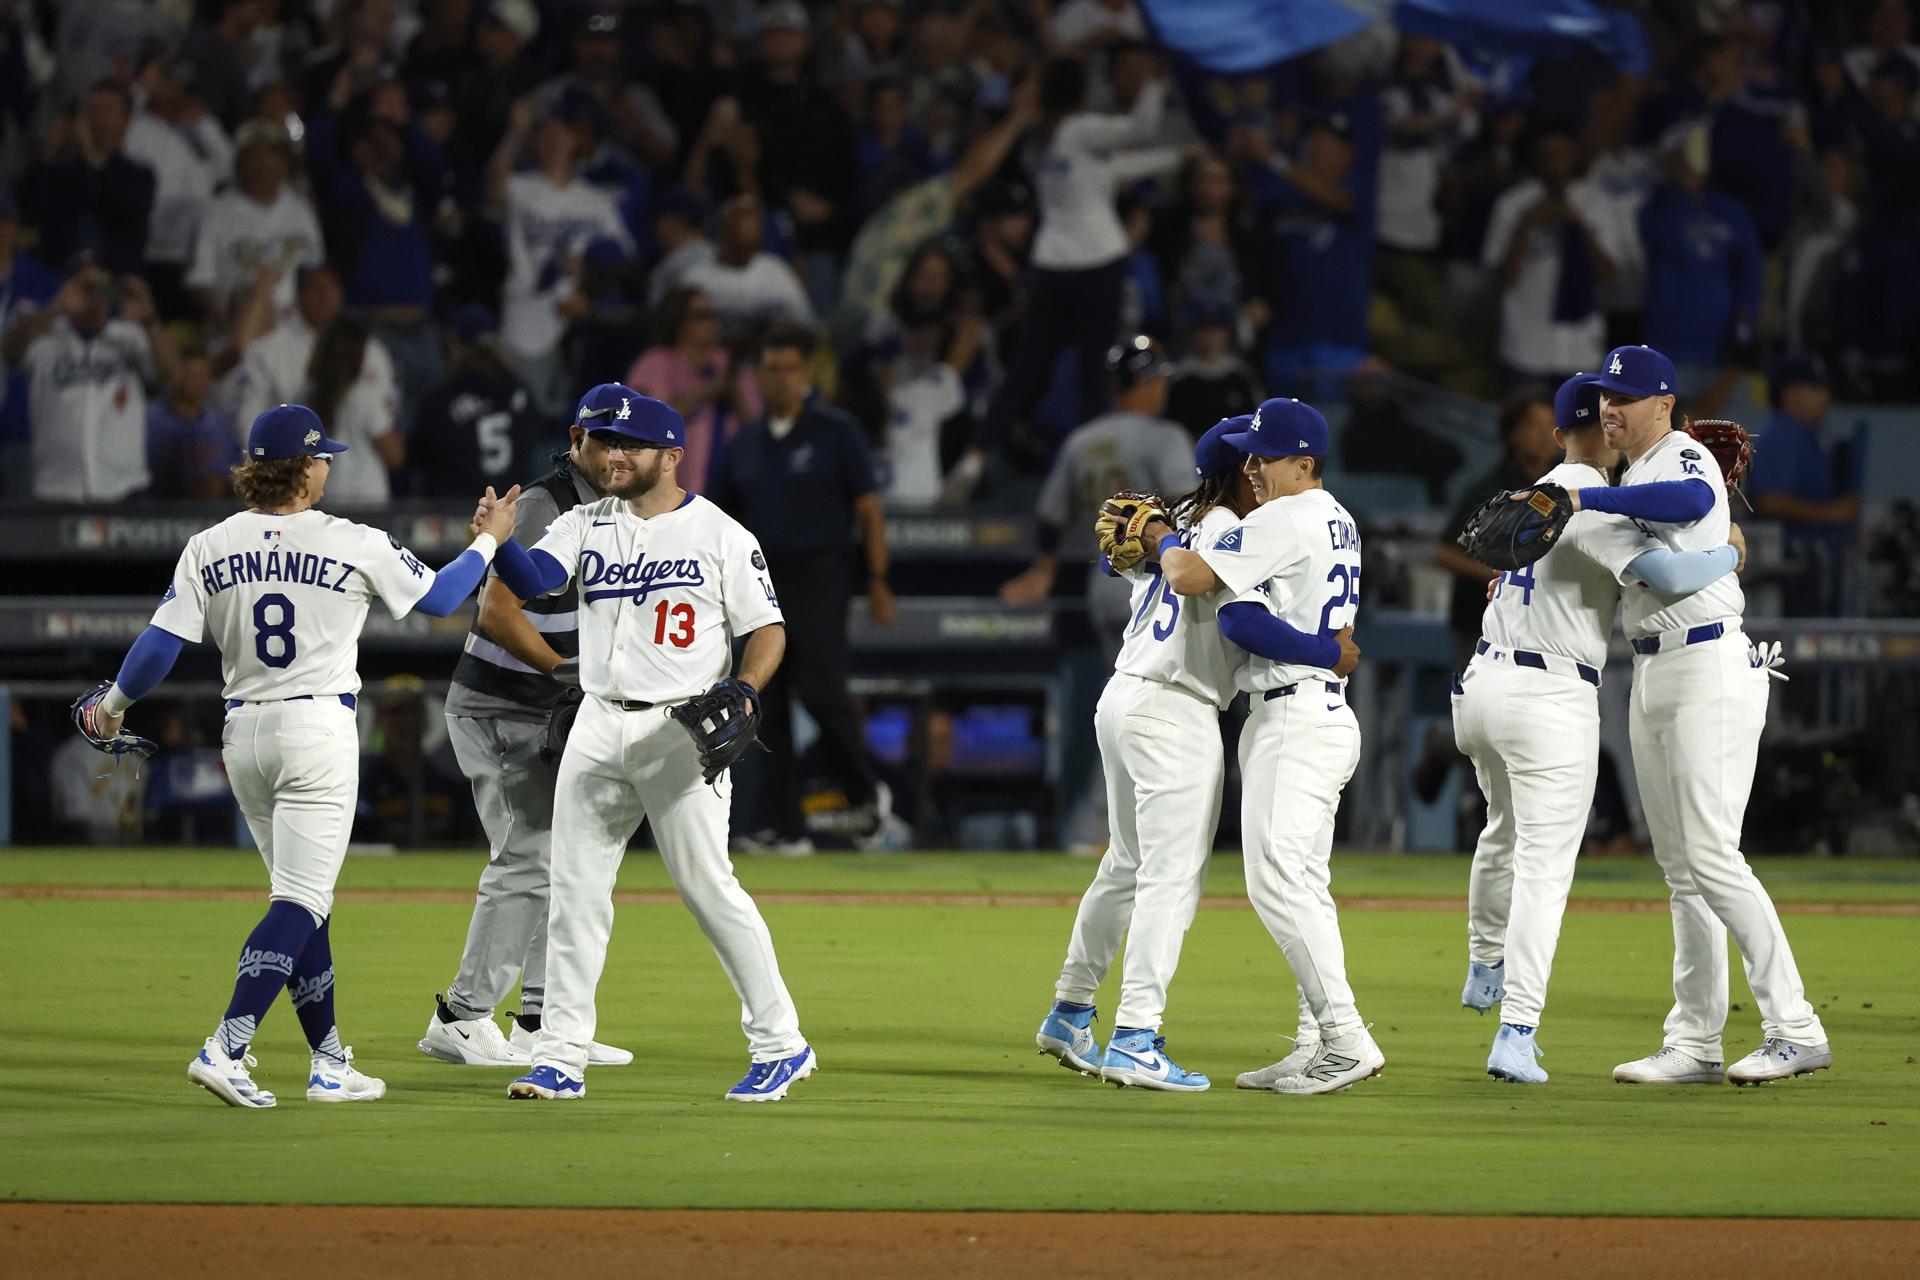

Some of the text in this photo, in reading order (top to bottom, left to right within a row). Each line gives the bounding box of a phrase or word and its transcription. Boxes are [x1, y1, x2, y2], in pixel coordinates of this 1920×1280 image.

[1609, 353, 1622, 375] LA
[616, 398, 631, 420] LA
[477, 411, 513, 475] 5
[1680, 460, 1701, 475] LA
[1327, 519, 1361, 554] EDMAN
[201, 544, 356, 596] HERNÁNDEZ
[400, 553, 425, 580] LA
[580, 549, 705, 607] Dodgers
[757, 577, 778, 608] LA
[1132, 560, 1180, 642] 75
[253, 593, 296, 669] 8
[654, 599, 696, 648] 13
[237, 945, 294, 980] dgers
